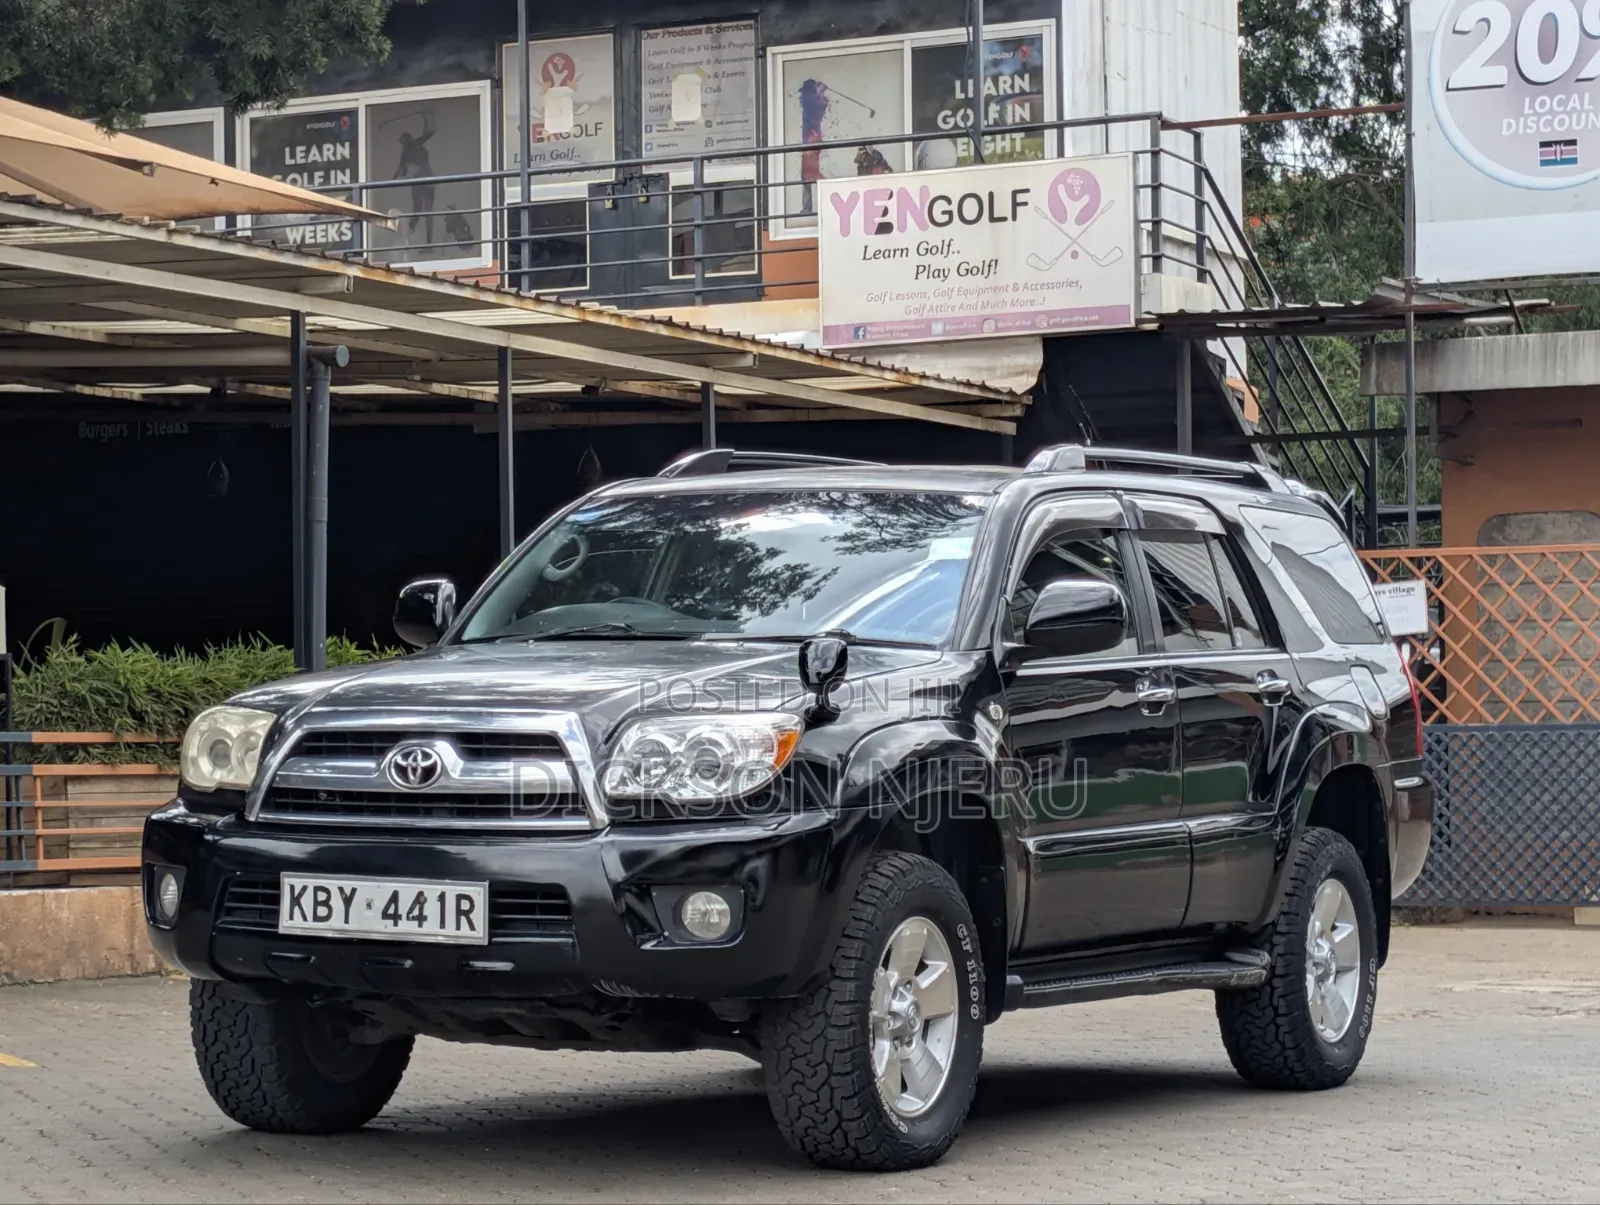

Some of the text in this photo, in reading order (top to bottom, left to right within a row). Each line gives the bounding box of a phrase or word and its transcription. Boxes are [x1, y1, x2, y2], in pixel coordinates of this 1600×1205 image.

[662, 27, 703, 38] Products
[705, 25, 713, 34] &
[715, 23, 754, 34] Services
[670, 46, 686, 57] Golf
[648, 62, 664, 71] Golf
[665, 59, 704, 70] Equipment
[714, 55, 754, 65] Accessories
[648, 77, 664, 86] Golf
[722, 70, 746, 79] Events
[704, 85, 722, 95] Club
[648, 103, 665, 113] Golf
[1523, 92, 1594, 115] LOCAL
[937, 102, 1030, 130] GOF IN
[1501, 113, 1600, 136] DISCOUN
[284, 141, 350, 166] LEARN
[329, 168, 351, 186] IN
[829, 184, 1031, 238] YENGOLF
[285, 221, 353, 245] WEEKS
[861, 239, 961, 261] Learn Golf..
[914, 258, 999, 283] Play Golf!
[866, 278, 1083, 305] Golf Lessons, Golf Equipment & Accessories,
[905, 303, 927, 316] Golf
[928, 302, 957, 315] Attire
[958, 301, 979, 312] And
[981, 299, 1008, 311] Much
[78, 421, 128, 443] Burgers
[1388, 586, 1416, 596] village
[289, 884, 477, 931] KBY 441R
